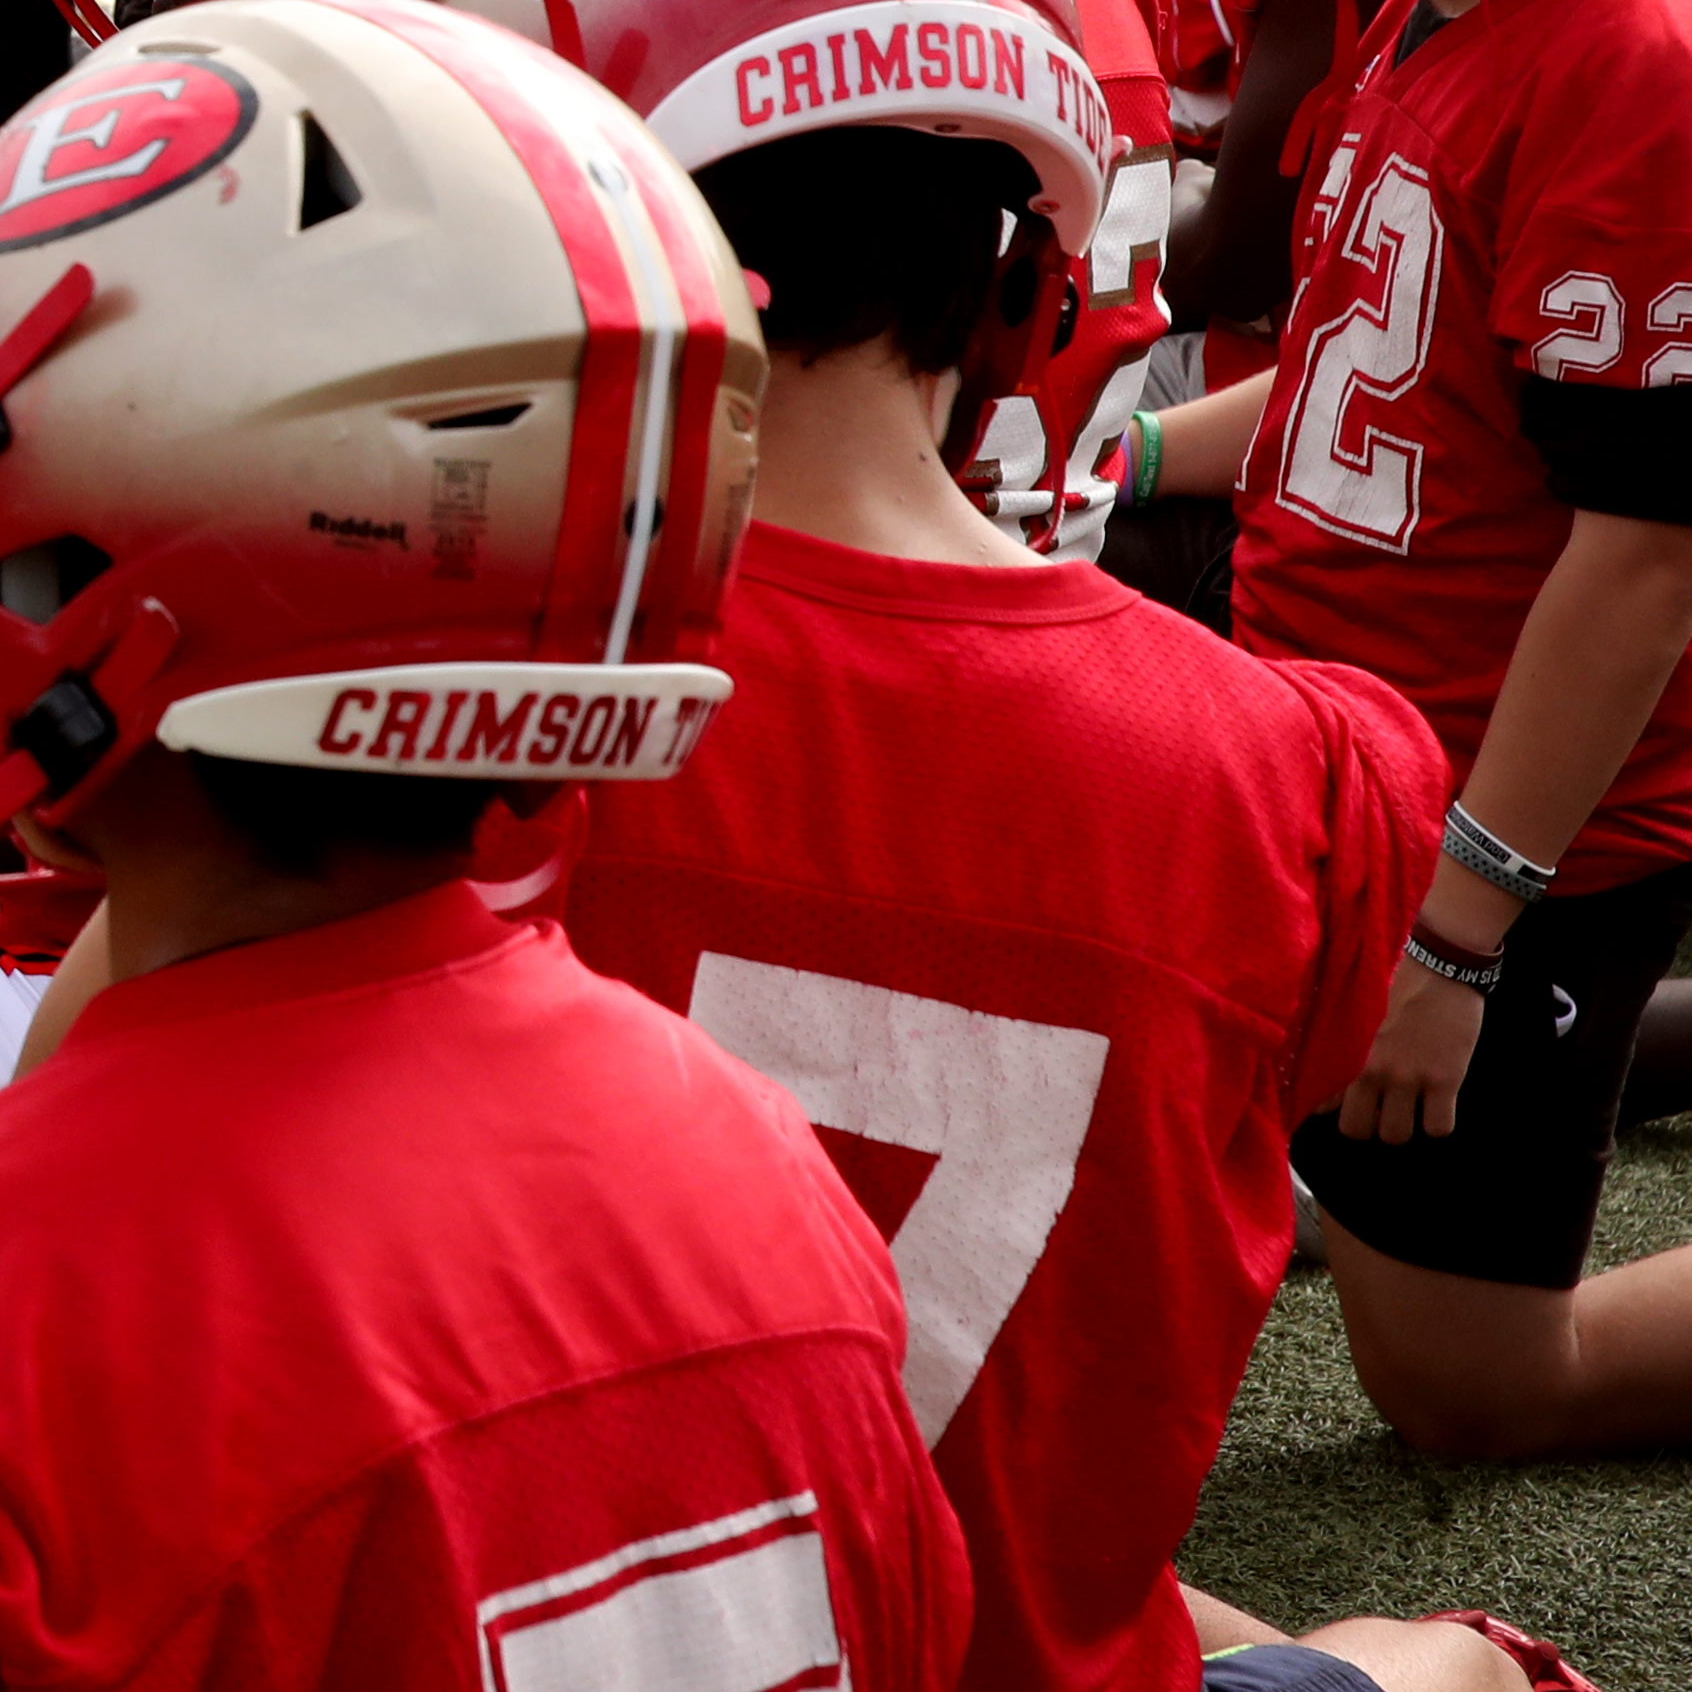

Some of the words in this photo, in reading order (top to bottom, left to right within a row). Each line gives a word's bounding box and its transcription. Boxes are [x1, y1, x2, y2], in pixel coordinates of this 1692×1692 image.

[736, 22, 1027, 128] CRIMSON
[1530, 269, 1692, 390] 22
[318, 688, 657, 767] CRIMSON
[1457, 968, 1478, 985] MY
[688, 950, 1110, 1454] 7
